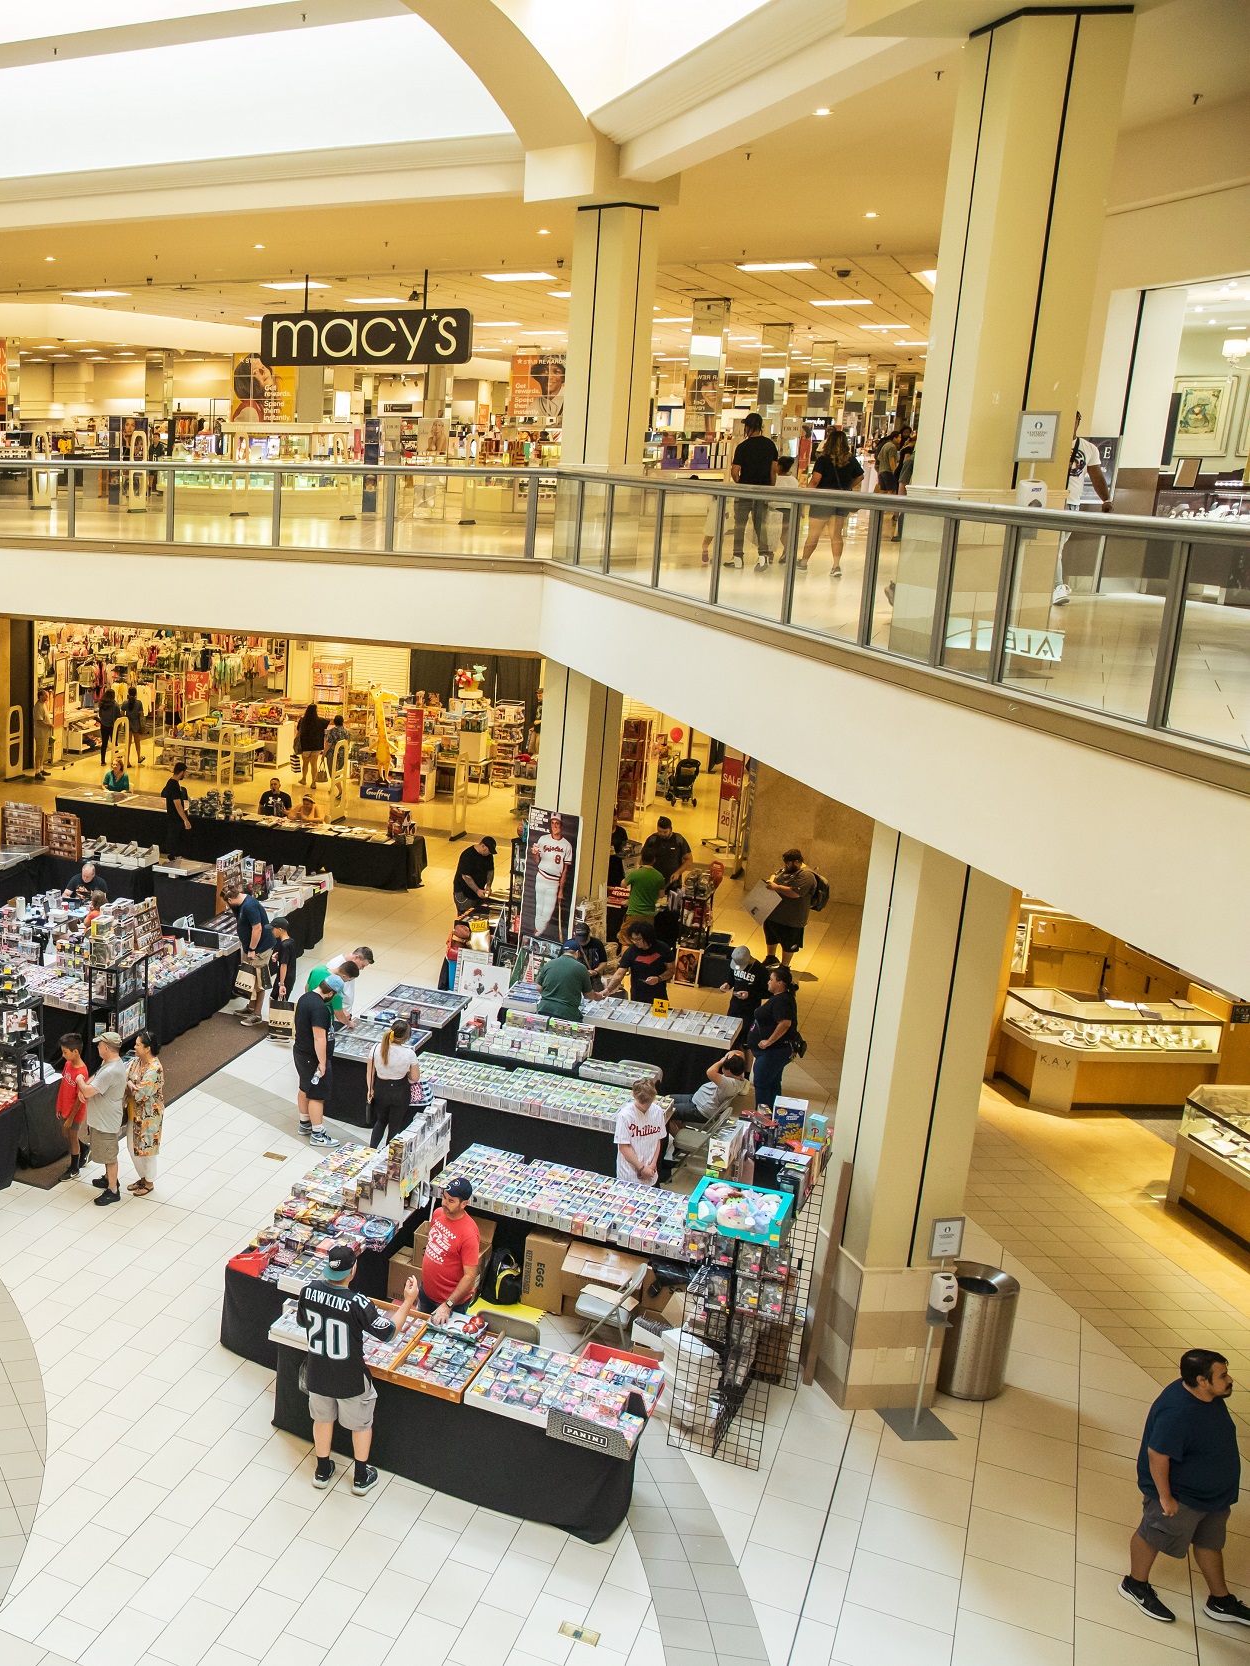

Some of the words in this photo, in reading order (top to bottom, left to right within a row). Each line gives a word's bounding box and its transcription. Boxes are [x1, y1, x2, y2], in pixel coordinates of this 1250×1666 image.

[271, 312, 457, 361] macy's
[722, 773, 742, 787] SALE
[365, 787, 391, 800] Geoffrey
[554, 854, 562, 865] 8
[1040, 1054, 1071, 1068] KAY
[628, 1123, 661, 1138] Phillies
[535, 1261, 546, 1289] EGGS
[305, 1287, 352, 1313] DAWKINS
[305, 1307, 349, 1360] 20
[566, 1427, 605, 1445] PANINI
